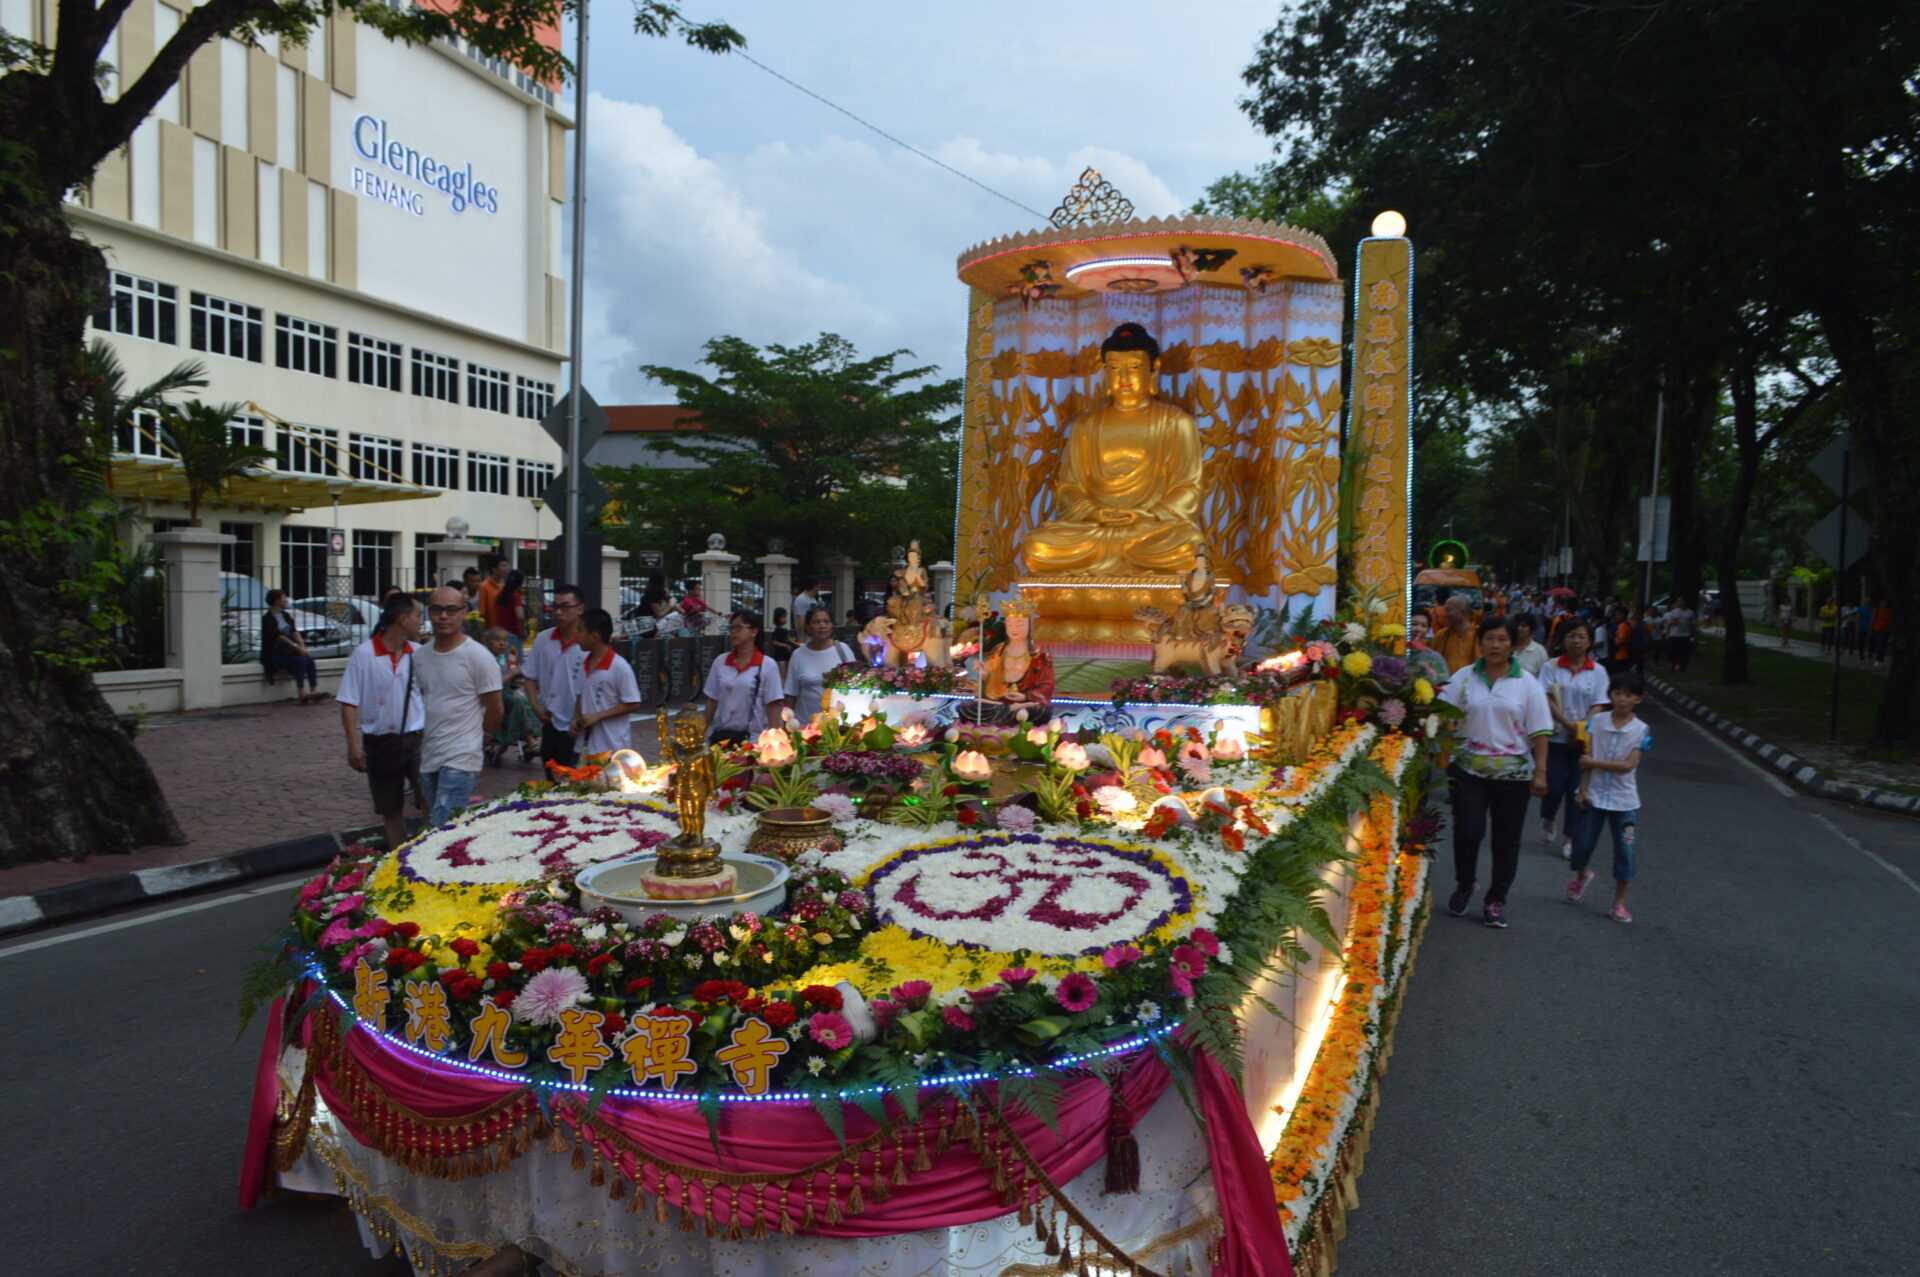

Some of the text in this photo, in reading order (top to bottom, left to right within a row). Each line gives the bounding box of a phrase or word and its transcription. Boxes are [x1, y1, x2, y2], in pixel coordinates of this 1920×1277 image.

[354, 114, 498, 214] Gleneagles
[354, 167, 424, 216] PENANG
[352, 956, 790, 1096] 新港九華禪寺
